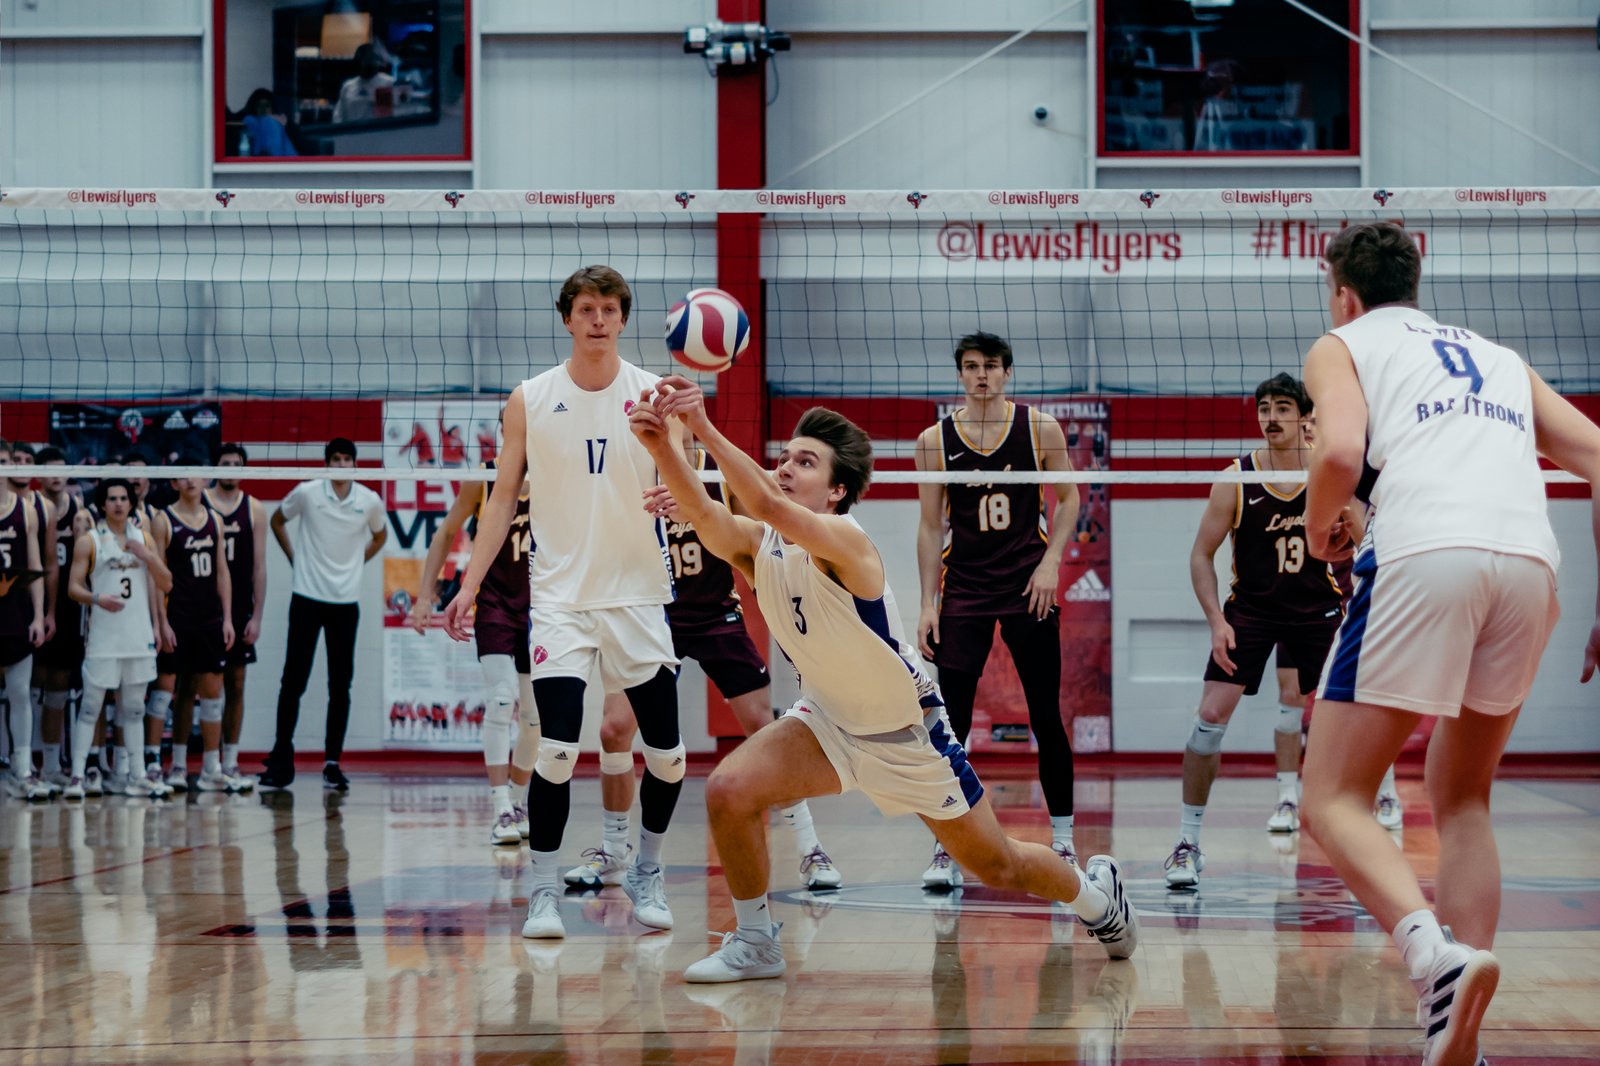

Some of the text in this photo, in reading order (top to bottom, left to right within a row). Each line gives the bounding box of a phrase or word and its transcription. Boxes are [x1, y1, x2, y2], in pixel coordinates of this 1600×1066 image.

[68, 190, 156, 207] @LewisFlyers
[295, 190, 385, 208] @LewisFlyers
[525, 191, 615, 208] @LewisFlyers
[756, 191, 846, 208] @LewisFlyers
[988, 190, 1079, 208] @LewisFlyers
[1221, 190, 1312, 208] @LewisFlyers
[1455, 188, 1547, 205] @LewisFlyers
[938, 220, 1182, 273] @LewisFlyers
[1431, 338, 1484, 395] 9
[585, 438, 608, 474] 17
[978, 493, 1011, 532] 18
[191, 552, 213, 577] 10
[669, 541, 703, 579] 19
[1275, 536, 1305, 573] 13
[120, 577, 132, 599] 3
[792, 596, 808, 636] 3
